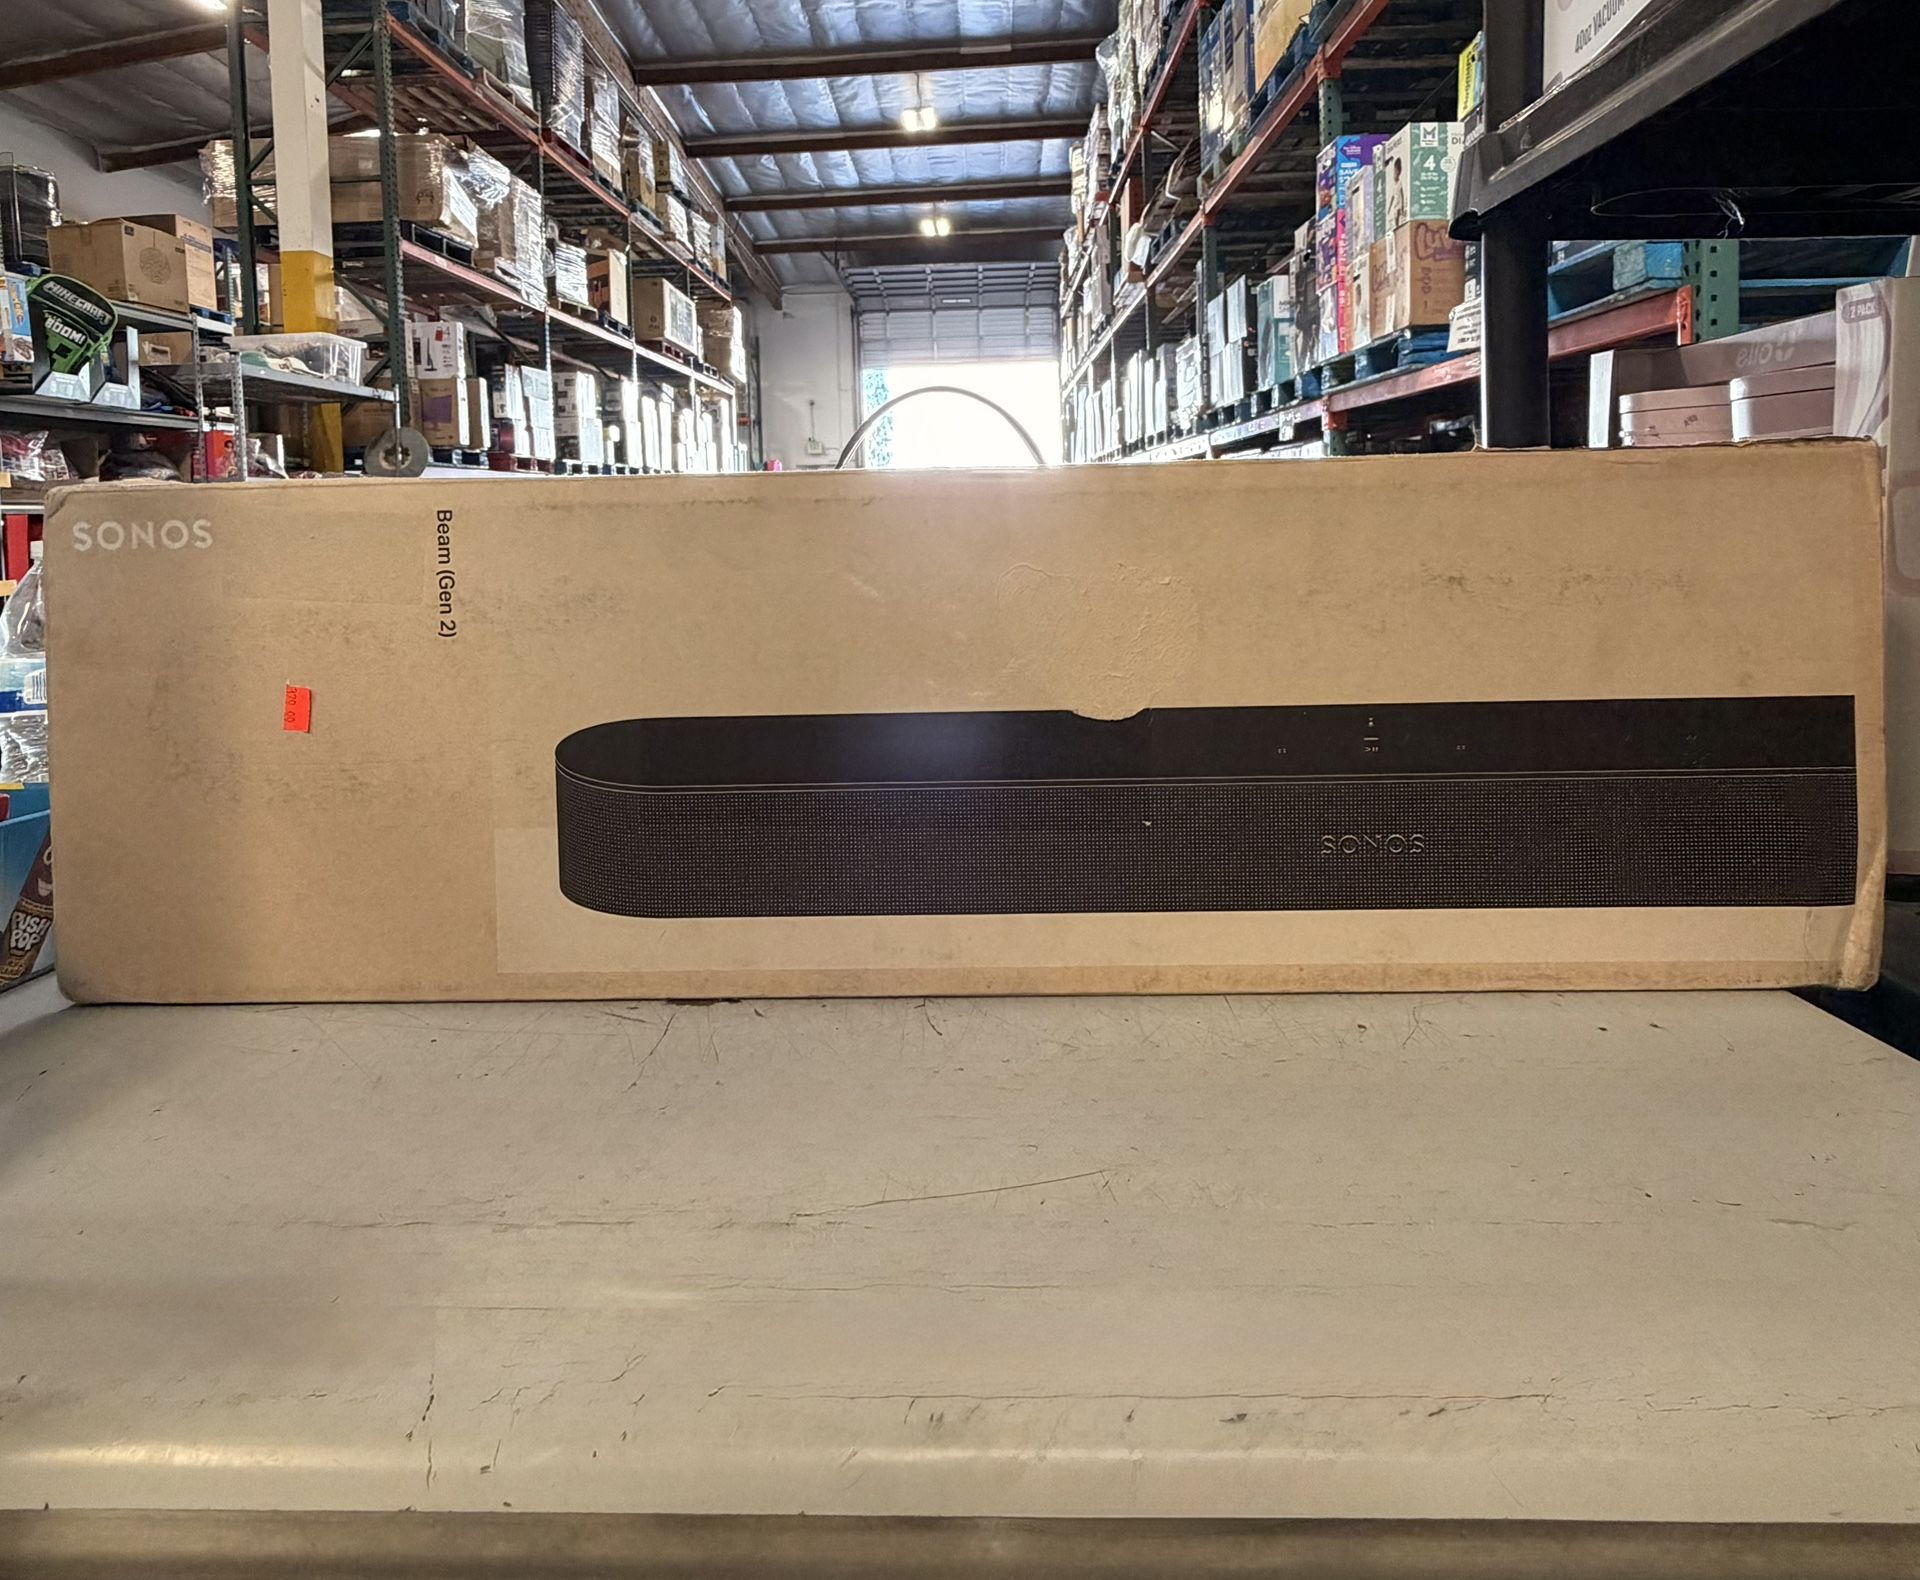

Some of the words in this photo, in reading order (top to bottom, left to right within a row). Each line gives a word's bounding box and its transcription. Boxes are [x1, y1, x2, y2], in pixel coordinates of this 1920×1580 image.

[1423, 154, 1436, 171] 4
[43, 280, 113, 326] MINECRAFT
[1849, 304, 1856, 319] 2
[1857, 302, 1876, 316] PACK
[44, 317, 86, 345] BOOM!
[72, 518, 214, 552] SONOS
[436, 509, 453, 564] Beam
[436, 569, 456, 615] (Gen
[437, 619, 457, 638] 2)
[1320, 833, 1425, 855] SONOS
[12, 910, 51, 936] PUSH
[10, 928, 41, 951] POP
